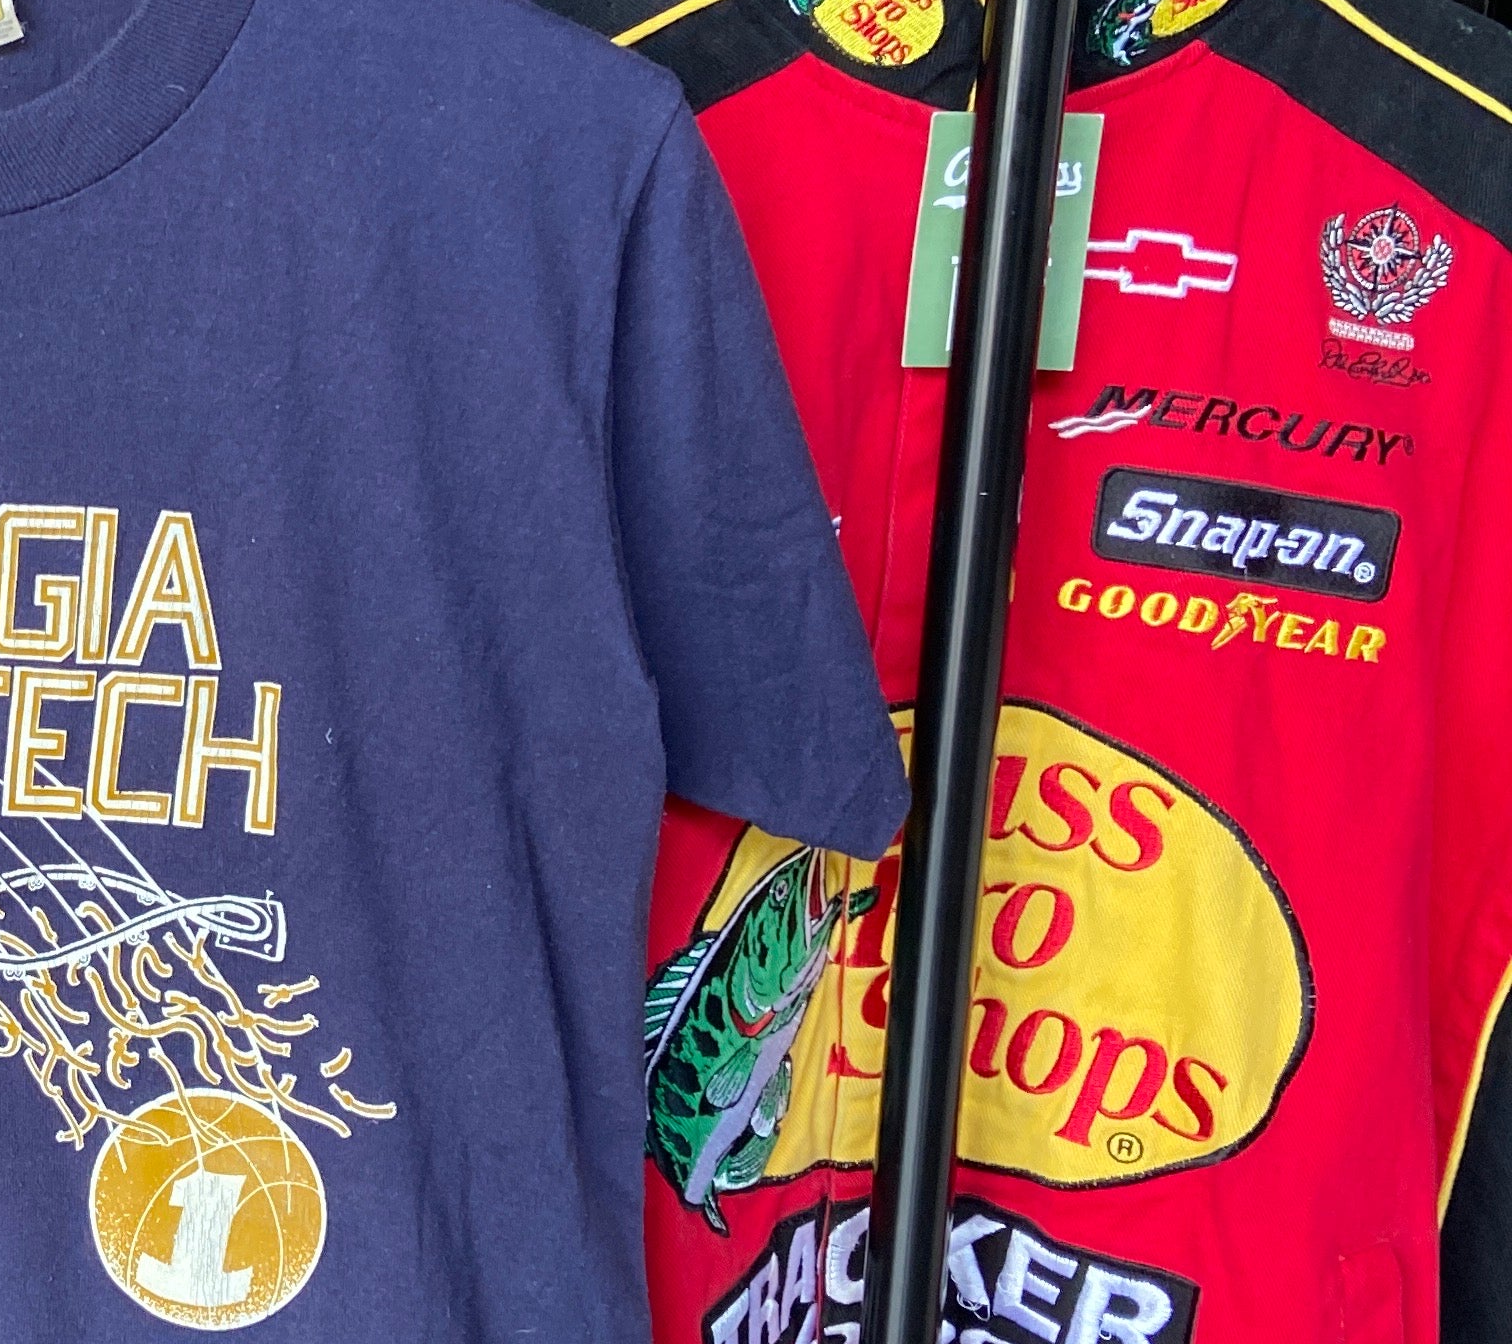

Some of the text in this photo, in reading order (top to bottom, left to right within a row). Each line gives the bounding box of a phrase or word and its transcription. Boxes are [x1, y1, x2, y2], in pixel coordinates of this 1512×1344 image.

[841, 2, 912, 64] Shops
[1088, 385, 1402, 465] MERCURY
[1106, 490, 1365, 574] Snap-on
[1057, 578, 1387, 663] GOODYEAR
[136, 1166, 254, 1308] 1
